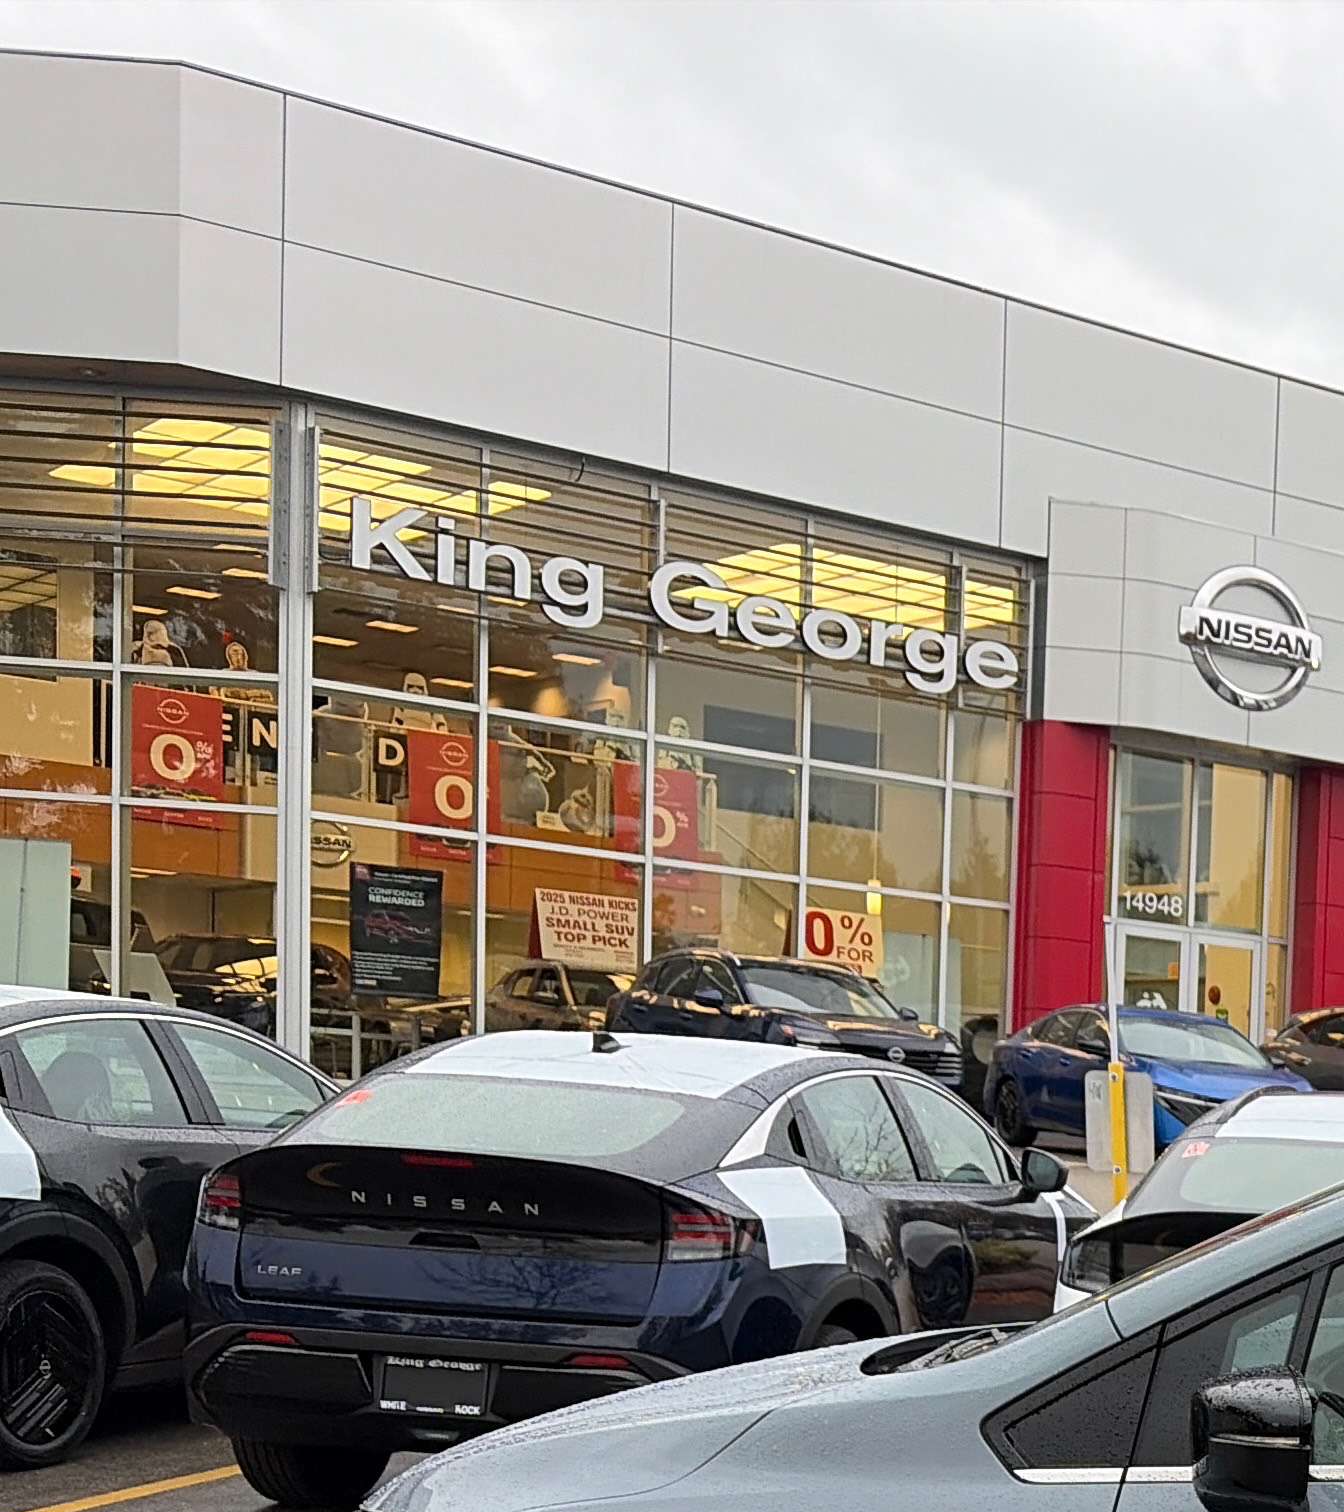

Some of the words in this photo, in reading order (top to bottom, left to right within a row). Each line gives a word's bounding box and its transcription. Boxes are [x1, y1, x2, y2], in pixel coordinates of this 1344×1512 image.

[351, 496, 602, 628] King
[651, 562, 1019, 694] George
[1198, 616, 1312, 659] NISSAN
[311, 836, 351, 848] SSAN
[368, 886, 424, 899] CONFIDENCE
[368, 893, 425, 907] REWARDED
[540, 891, 566, 904] 2025
[568, 895, 605, 909] NISSAN
[608, 899, 637, 912] KICKS
[1123, 890, 1183, 917] 14948
[550, 905, 573, 917] J.D.
[577, 907, 629, 923] POWER
[545, 916, 600, 933] SMALL
[605, 923, 635, 936] SUV
[554, 930, 587, 943] TOP
[591, 935, 630, 948] PICK
[836, 946, 874, 963] FOR
[351, 1190, 539, 1216] NISSAN
[257, 1264, 302, 1276] LEAF
[380, 1400, 407, 1411] WHITE
[455, 1404, 481, 1416] ROCK
